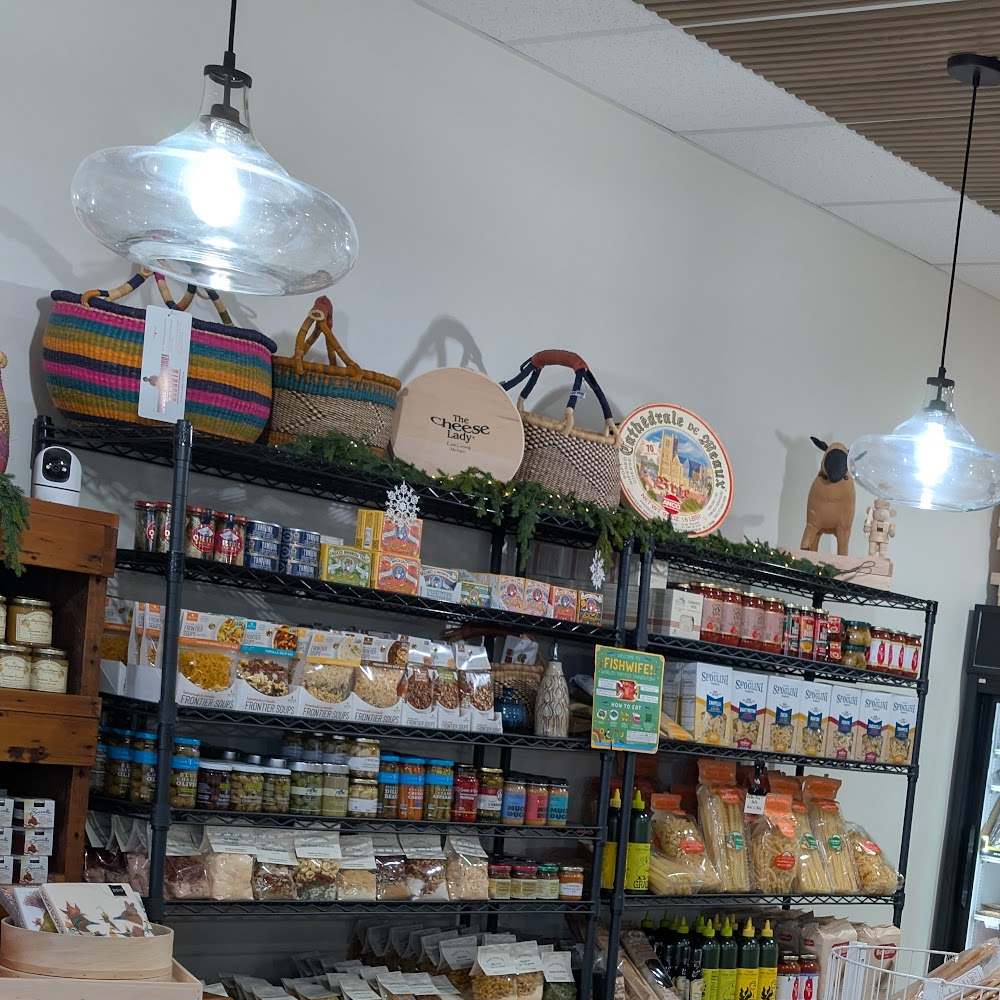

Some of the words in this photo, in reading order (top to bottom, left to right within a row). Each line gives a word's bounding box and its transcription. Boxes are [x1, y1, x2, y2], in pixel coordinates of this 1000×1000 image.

[430, 416, 490, 435] Cheese
[452, 414, 470, 424] The
[447, 429, 472, 443] Lady
[663, 498, 681, 510] ANCO
[603, 657, 653, 675] FISHWIFE!
[181, 694, 213, 707] FRONTIER
[213, 698, 234, 709] SOUPS
[245, 701, 275, 712] FRONTIER
[275, 704, 295, 714] SOUPS
[303, 707, 331, 718] FRONTIER
[332, 710, 350, 720] SOUPS
[355, 712, 383, 723] FRONTIER
[383, 715, 400, 724] SOUPS
[441, 722, 458, 730] FRONTIER
[476, 724, 492, 732] FRONTIER
